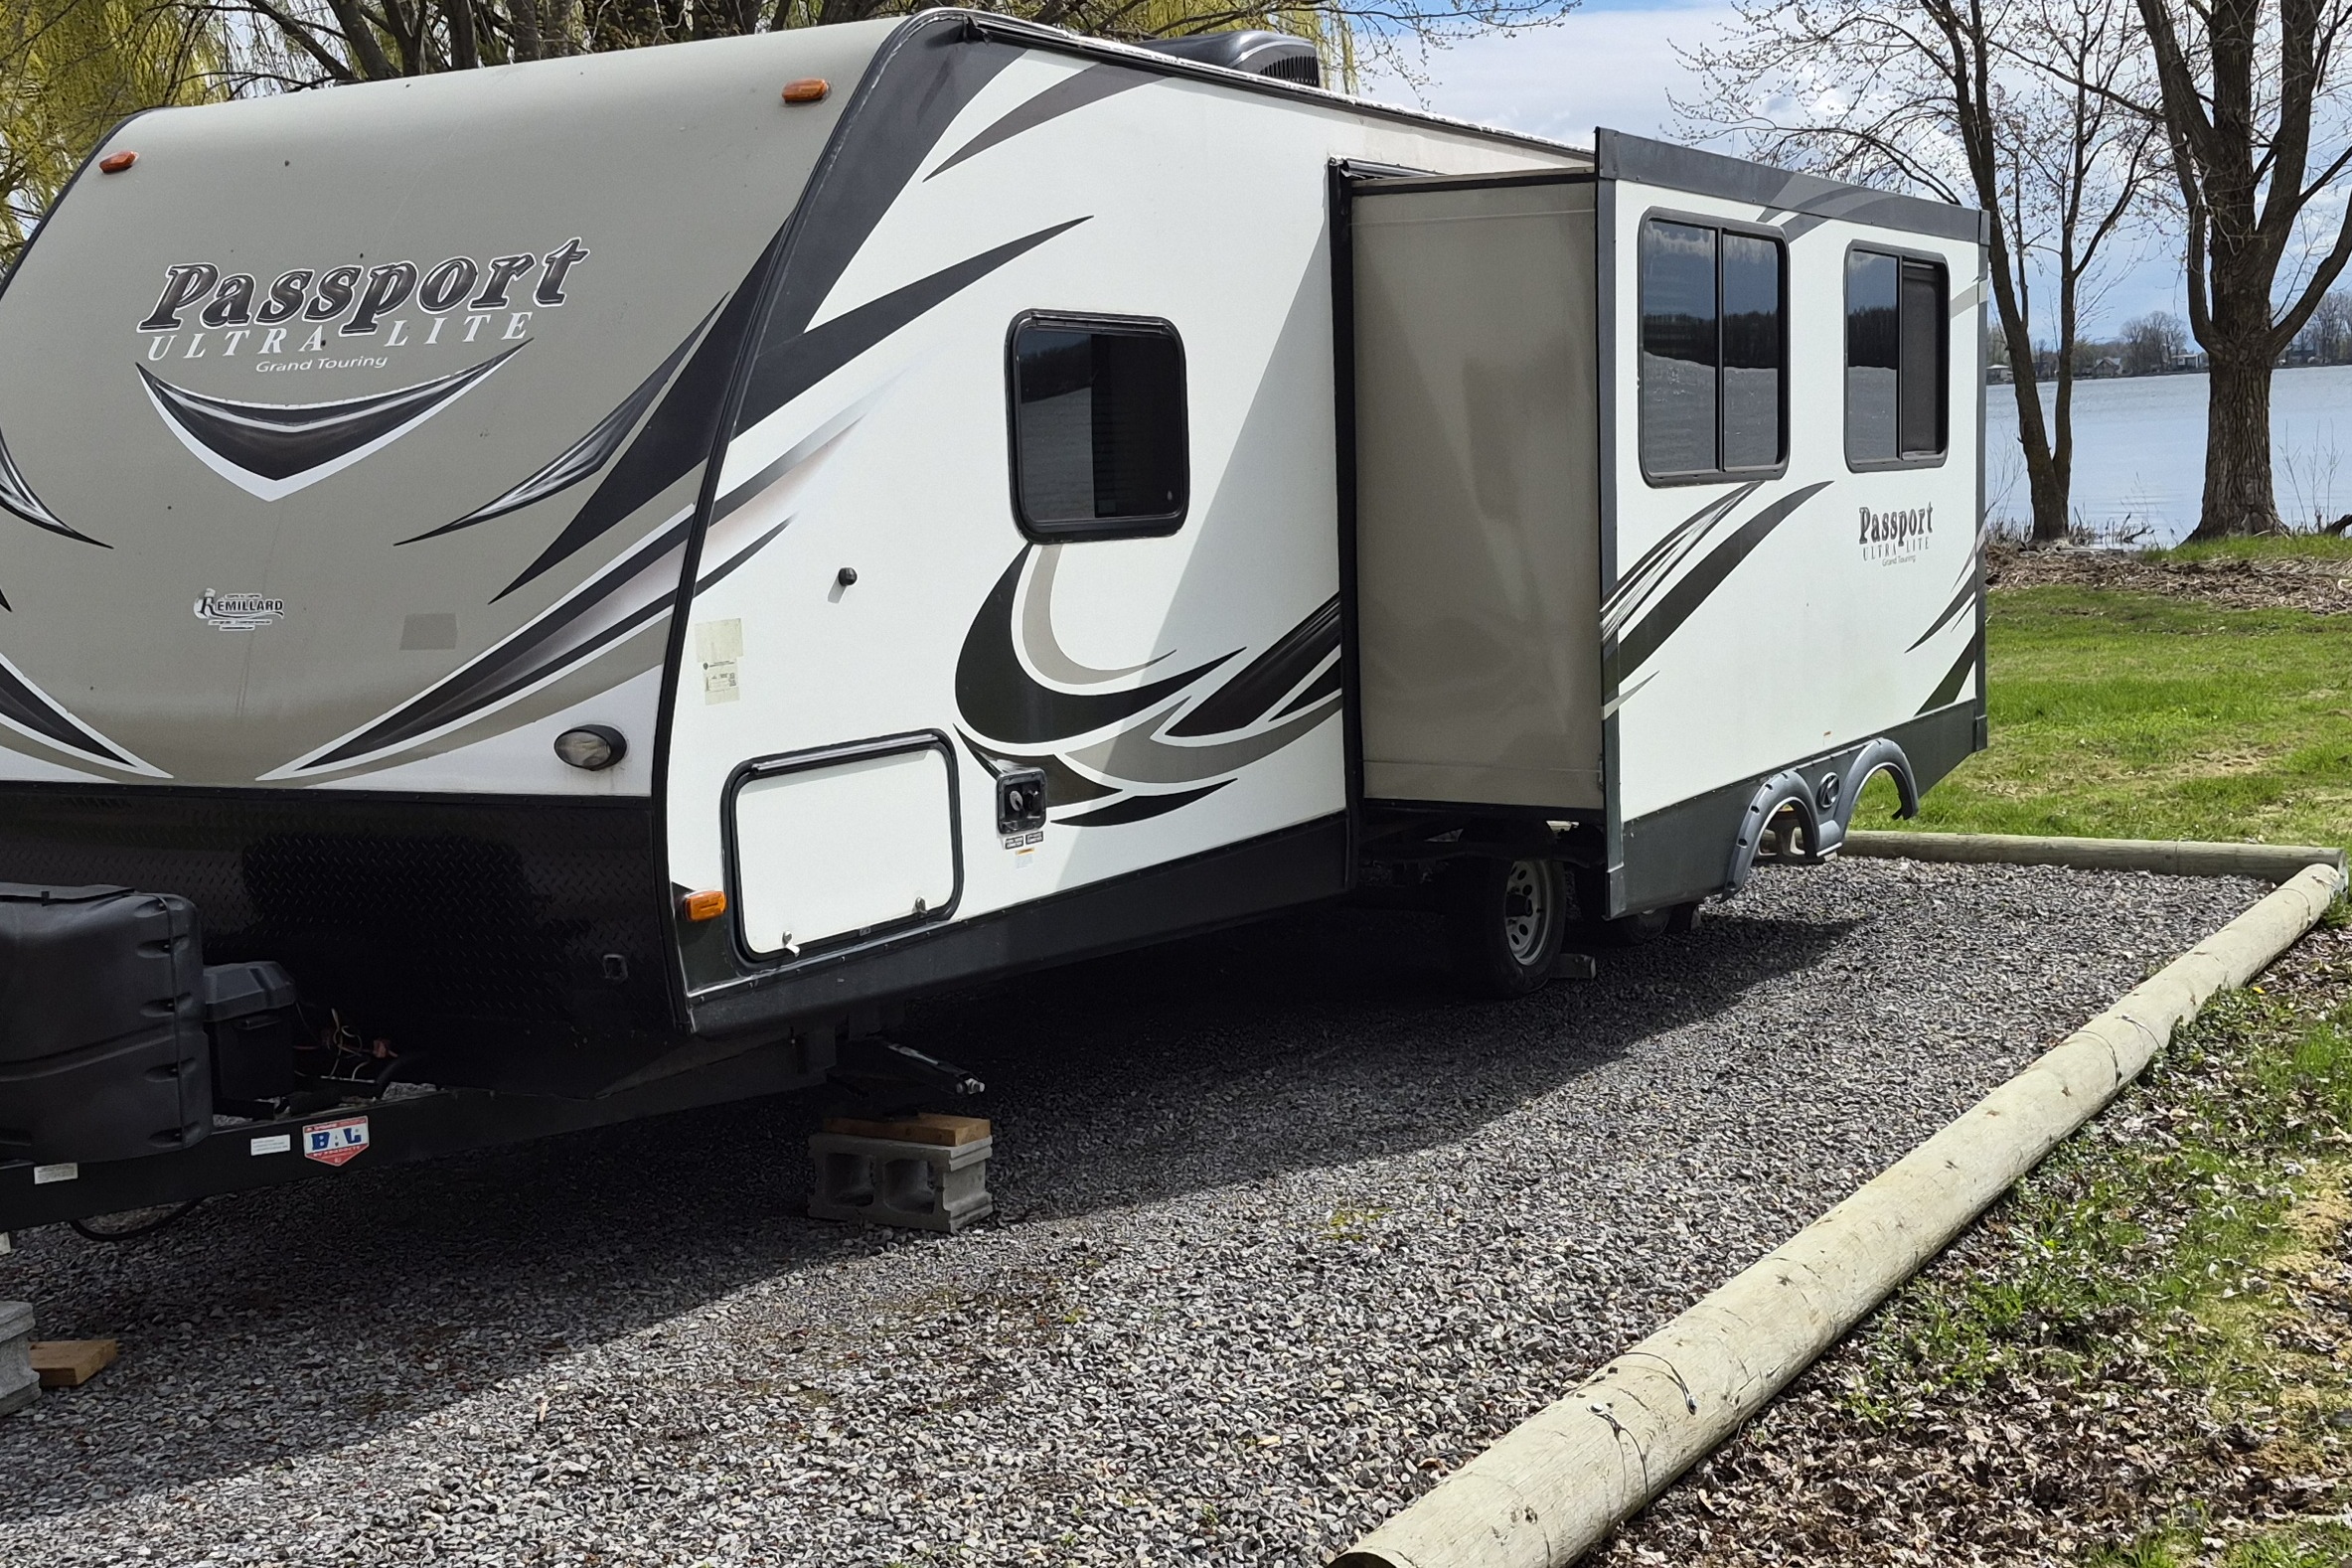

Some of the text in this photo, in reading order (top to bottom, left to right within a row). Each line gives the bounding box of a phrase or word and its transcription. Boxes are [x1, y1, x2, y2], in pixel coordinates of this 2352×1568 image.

[137, 236, 590, 334] Passport
[148, 311, 533, 361] ULTRA LITE
[255, 354, 389, 373] Grand Touring
[1859, 501, 1934, 548] Passport
[1863, 537, 1930, 561] ULTRA LITE
[199, 596, 284, 618] REMILLARD
[311, 1128, 362, 1151] BAL
